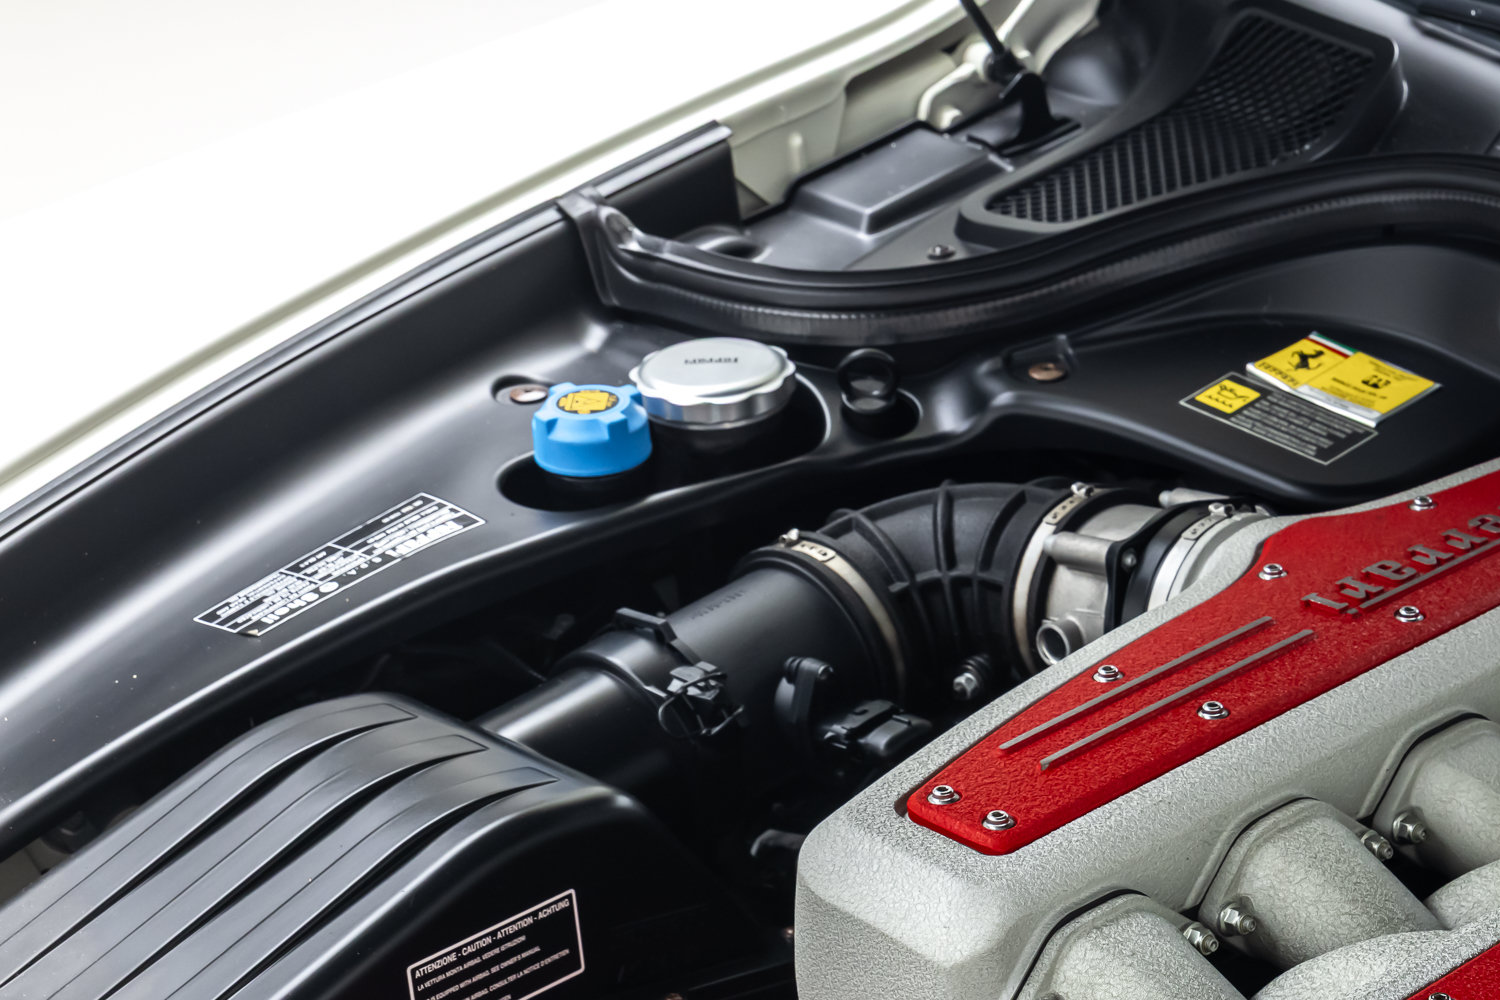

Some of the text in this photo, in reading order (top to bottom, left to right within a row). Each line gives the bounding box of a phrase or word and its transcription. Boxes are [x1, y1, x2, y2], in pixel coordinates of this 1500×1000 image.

[260, 591, 320, 625] Shell
[415, 952, 457, 979] ATTENZIONE
[462, 935, 492, 956] CAUTION
[496, 915, 533, 940] ATTENTION
[537, 898, 569, 920] ACHTUNG
[417, 983, 424, 992] LA
[424, 973, 445, 988] VETTURA
[436, 984, 459, 1000] EQUIPPED
